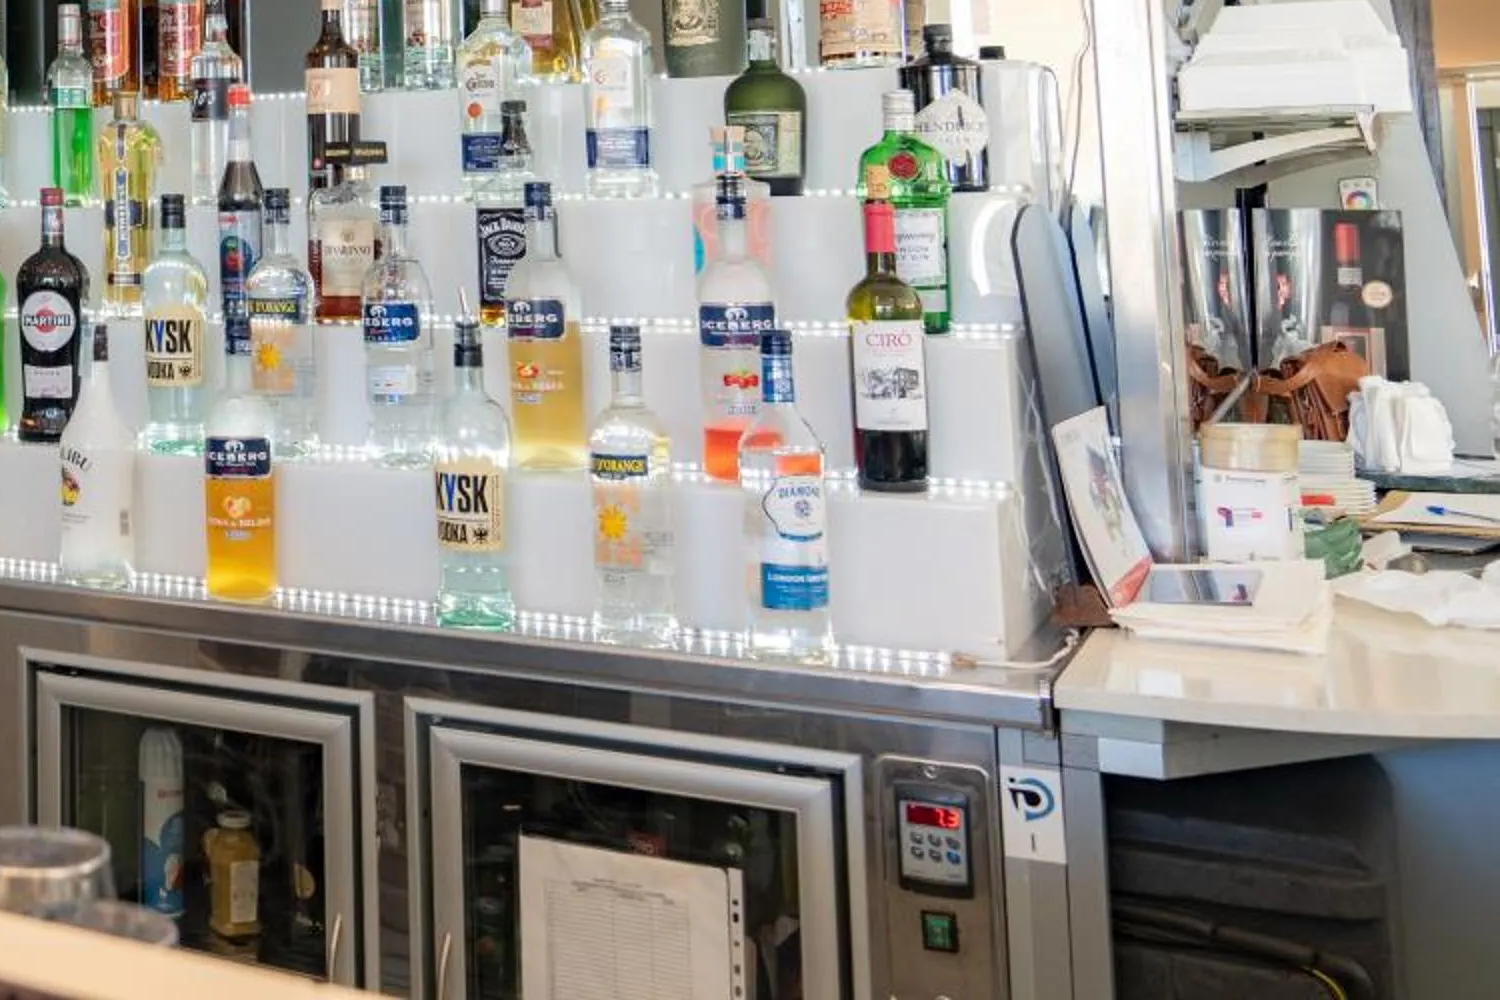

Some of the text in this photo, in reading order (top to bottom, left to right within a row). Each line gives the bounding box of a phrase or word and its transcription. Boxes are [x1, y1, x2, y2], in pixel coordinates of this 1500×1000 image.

[23, 314, 72, 327] MARTINI
[364, 317, 413, 327] EBERG
[145, 319, 192, 353] KYSK
[207, 451, 268, 462] CEBERG
[435, 471, 489, 513] KYSK
